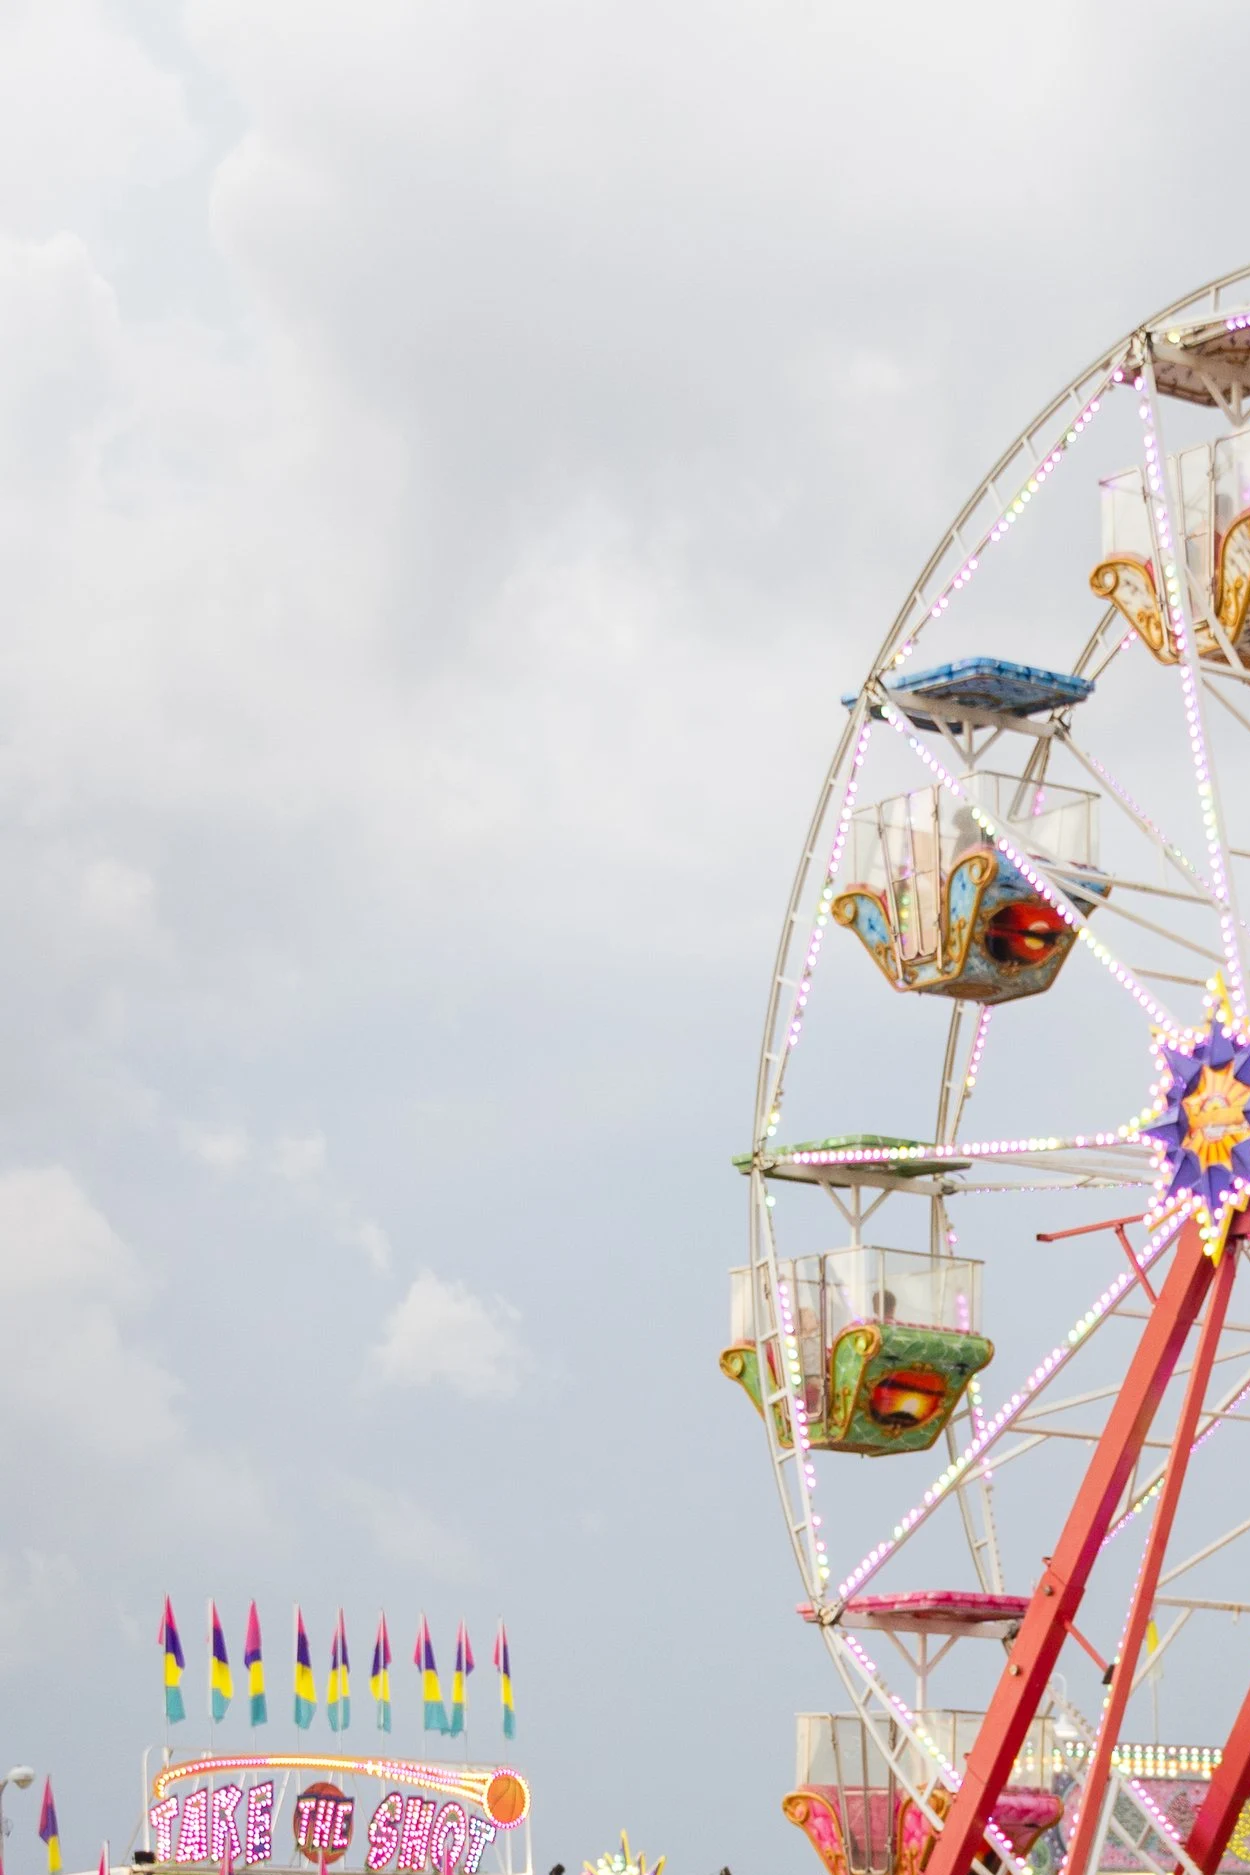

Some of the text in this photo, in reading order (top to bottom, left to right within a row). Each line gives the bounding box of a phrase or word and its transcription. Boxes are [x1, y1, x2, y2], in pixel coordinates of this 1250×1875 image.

[150, 1781, 496, 1874] TAKE THE SHOT
